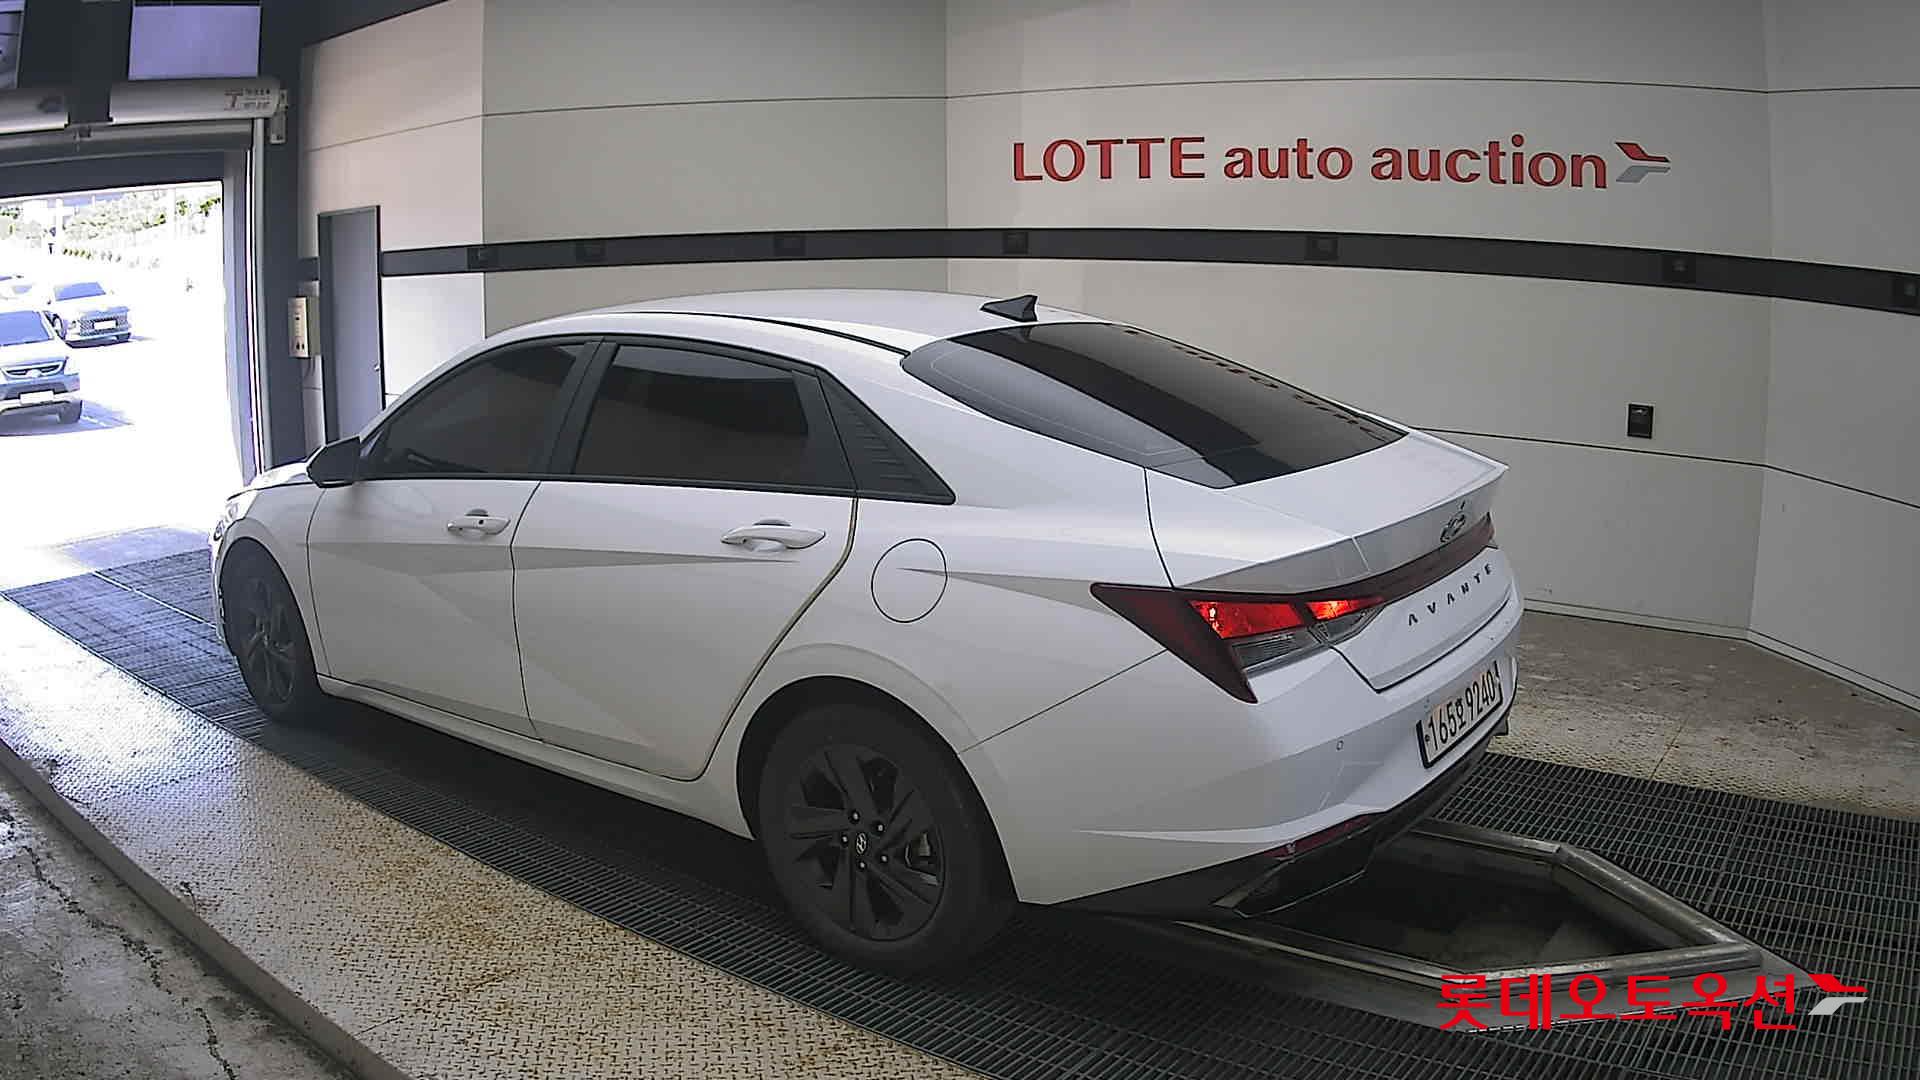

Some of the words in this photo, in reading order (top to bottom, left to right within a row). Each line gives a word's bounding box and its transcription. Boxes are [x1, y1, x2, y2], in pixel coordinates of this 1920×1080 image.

[1013, 137, 1205, 182] LOTTE
[1223, 138, 1353, 180] auto
[1370, 135, 1607, 188] auction
[1408, 563, 1492, 626] AVANTE
